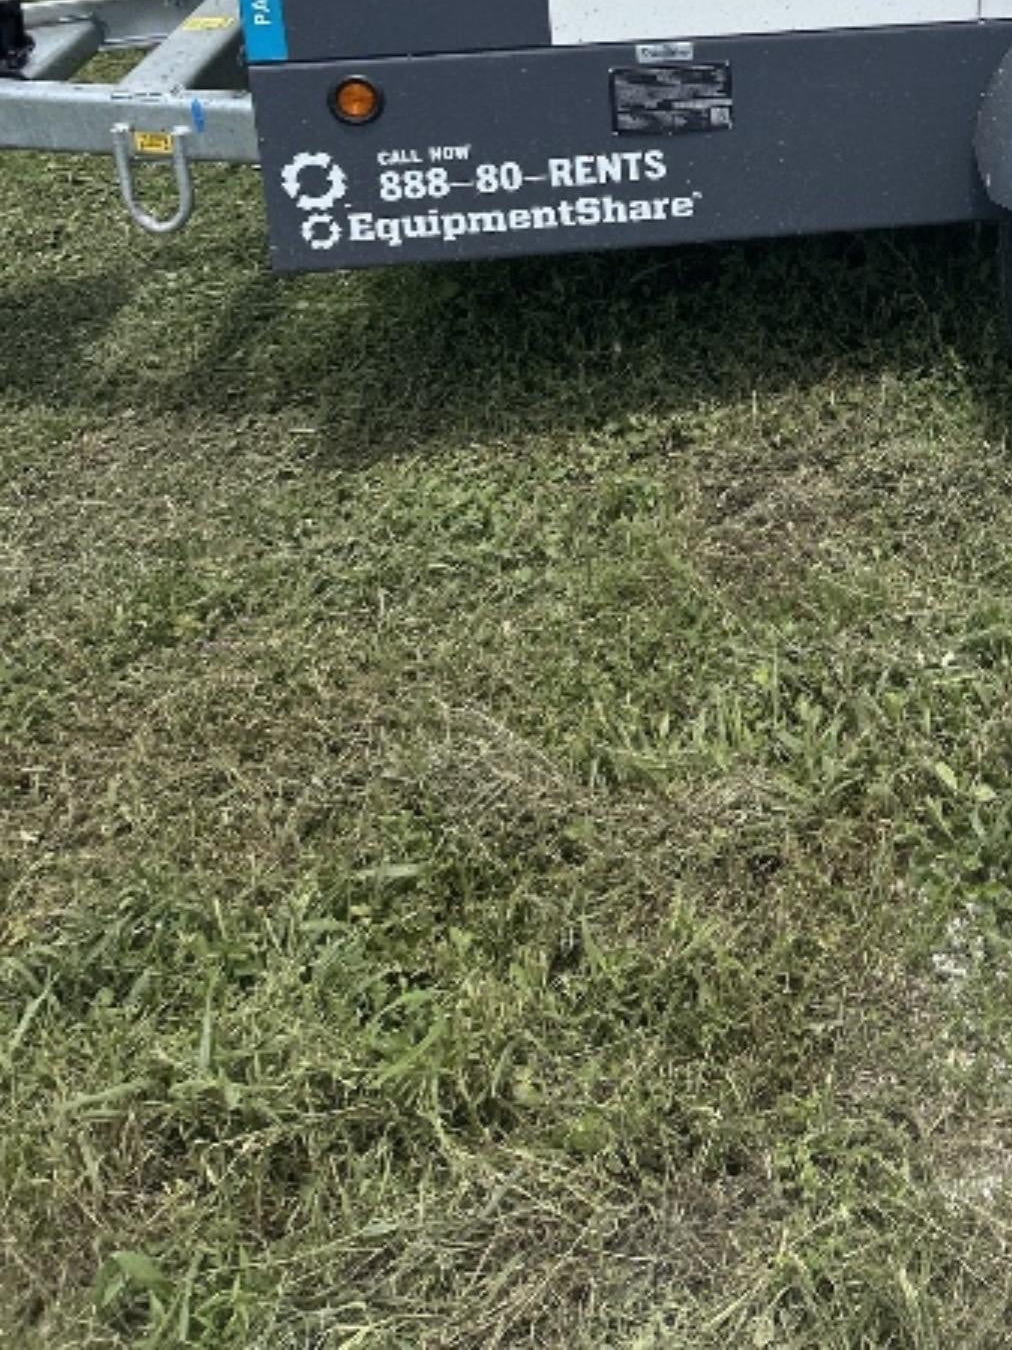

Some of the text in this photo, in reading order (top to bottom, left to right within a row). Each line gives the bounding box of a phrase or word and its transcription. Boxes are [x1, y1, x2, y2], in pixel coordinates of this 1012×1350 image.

[377, 144, 472, 166] CALL NOW
[347, 193, 696, 247] EquipmentShare
